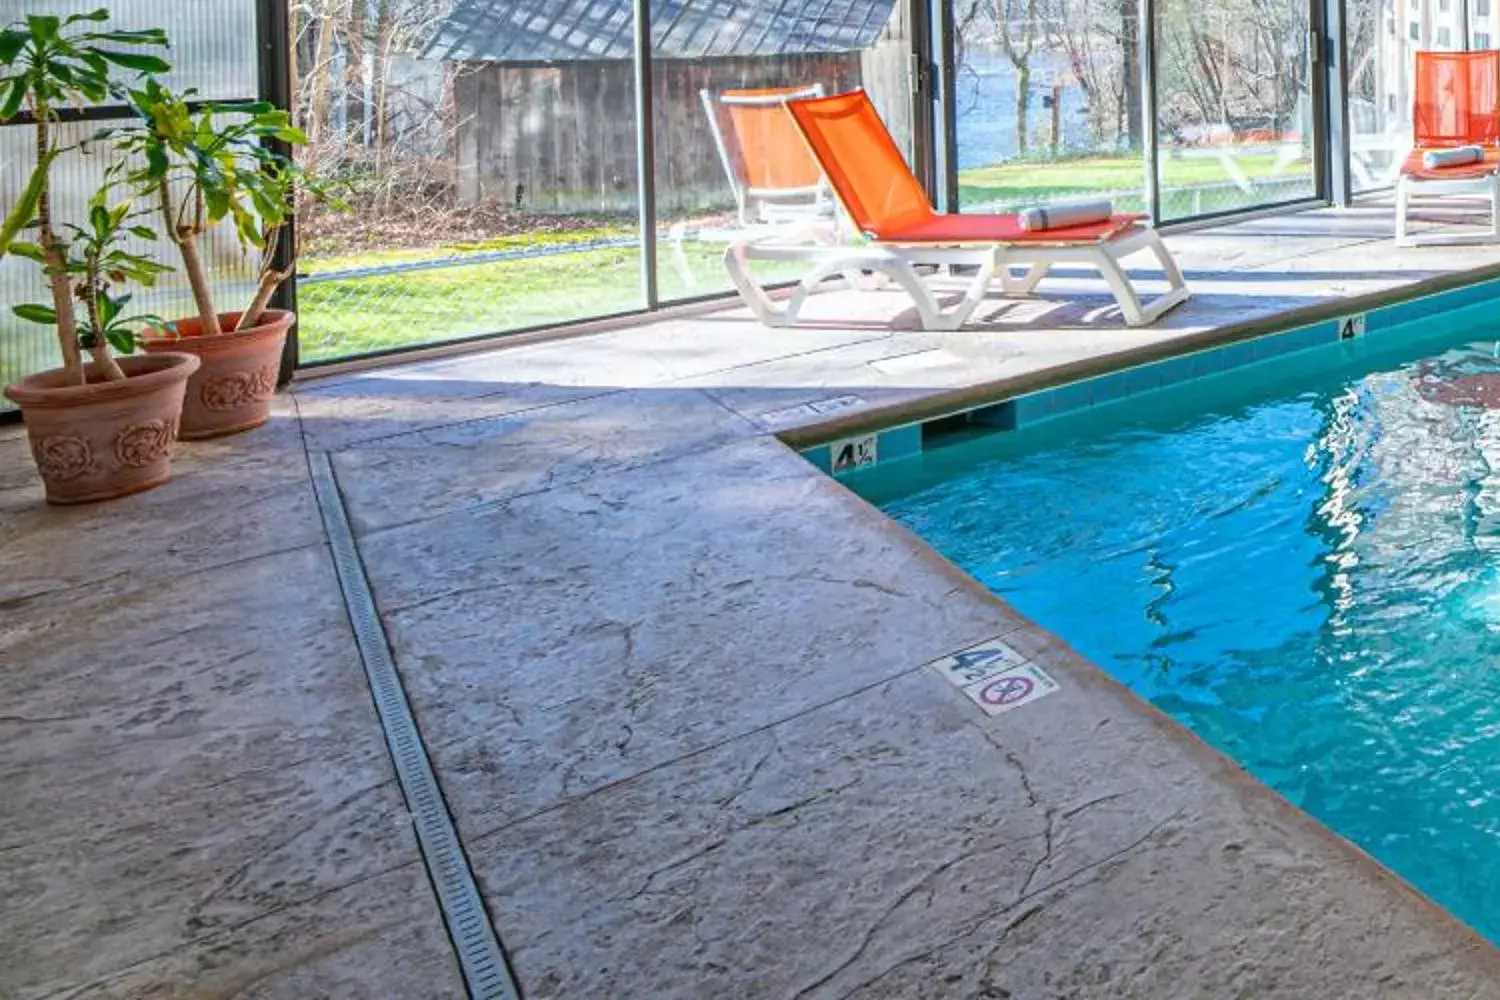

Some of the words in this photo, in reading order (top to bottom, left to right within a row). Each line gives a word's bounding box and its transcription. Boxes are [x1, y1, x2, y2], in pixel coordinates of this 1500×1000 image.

[1342, 318, 1356, 339] 4
[834, 443, 856, 470] 4
[950, 648, 1003, 670] 4
